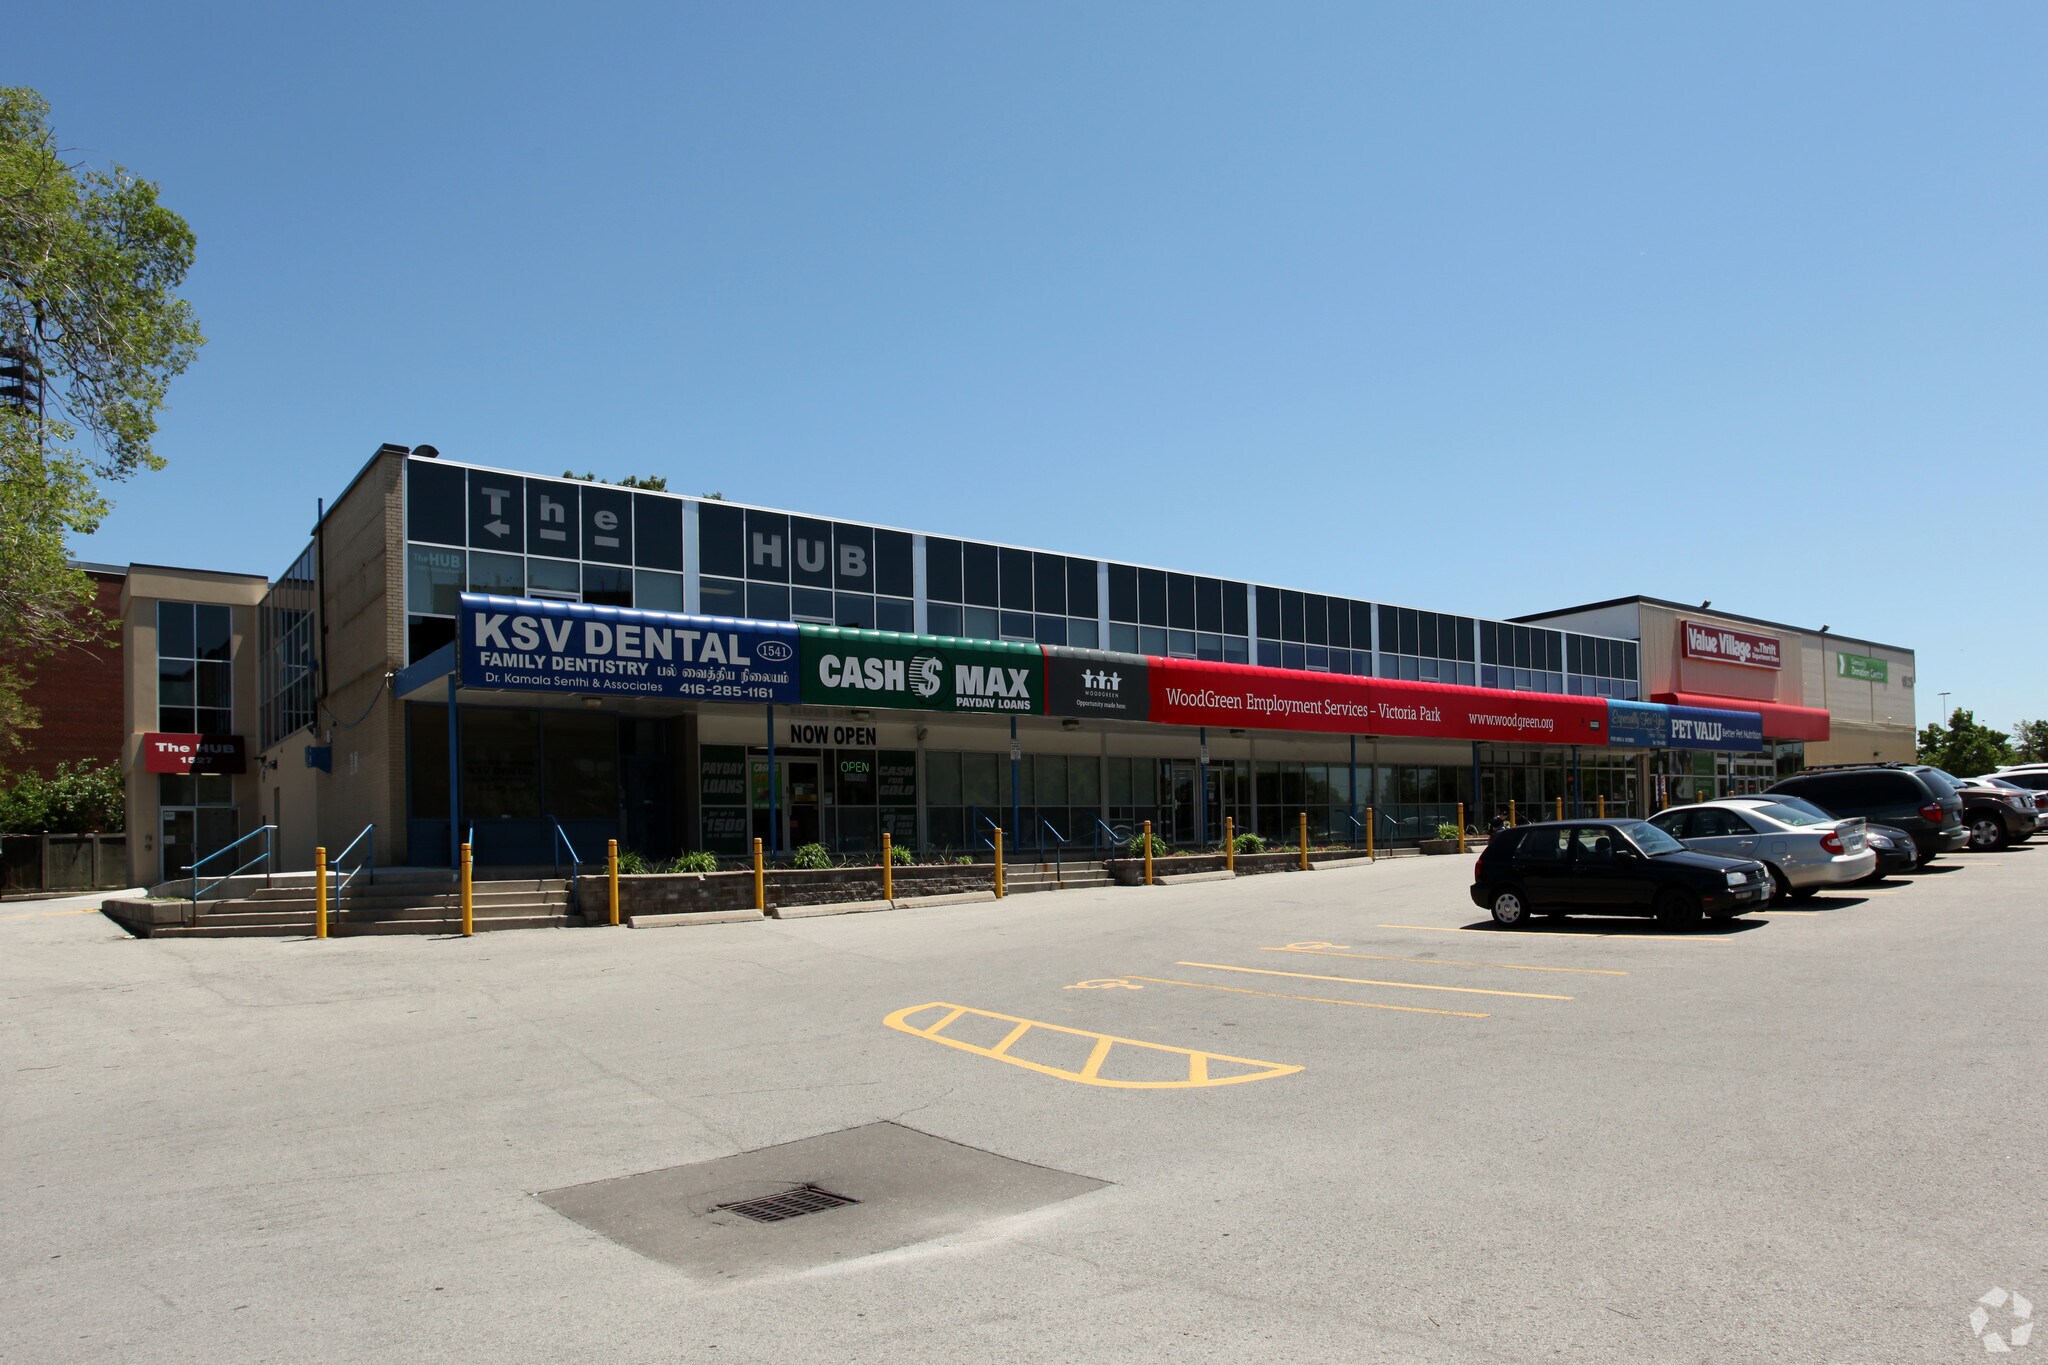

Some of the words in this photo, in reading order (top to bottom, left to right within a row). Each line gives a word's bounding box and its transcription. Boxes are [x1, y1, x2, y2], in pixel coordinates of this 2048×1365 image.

[482, 487, 618, 530] The
[429, 553, 461, 569] HUB
[752, 531, 867, 578] HUB
[475, 612, 574, 653] KSV
[584, 621, 751, 666] DENTAL
[1688, 627, 1718, 653] Value
[1718, 632, 1751, 662] Village
[762, 645, 786, 658] 1541
[1759, 642, 1777, 655] Thrift
[480, 651, 547, 669] FAMILY
[552, 656, 649, 676] DENTISTRY
[657, 663, 677, 677] பல்
[682, 667, 735, 682] வைத்திய
[740, 668, 790, 684] நிலையம்
[818, 654, 905, 691] CASH
[955, 664, 1030, 698] MAX
[485, 672, 501, 683] Dr.
[504, 673, 551, 685] Kamala
[554, 675, 589, 687] Senthi
[593, 678, 601, 688] &
[603, 679, 663, 692] Associates
[680, 683, 773, 698] 416-285-1161
[1084, 690, 1119, 698] WOODGREEN
[956, 697, 996, 708] PAYDAY
[998, 698, 1031, 710] LOANS
[1076, 699, 1104, 709] Opportunity
[1165, 687, 1242, 709] WoodGreen
[1246, 693, 1322, 717] Employment
[1324, 699, 1368, 717] Services
[1378, 703, 1417, 721] Victoria
[1419, 706, 1441, 722] Park
[1468, 712, 1554, 733] www.woodgreen.org
[1671, 719, 1693, 739] PET
[1693, 720, 1722, 741] VALU
[1722, 728, 1736, 738] Better
[1743, 730, 1762, 739] Nutrition
[790, 724, 828, 744] NOW
[834, 726, 877, 745] OPEN
[155, 742, 190, 753] The
[196, 743, 236, 754] HUB
[180, 756, 213, 764] 1527
[840, 761, 870, 773] OPEN
[701, 762, 744, 775] PAYDAY
[879, 765, 915, 776] CASH
[703, 779, 745, 794] LOANS
[879, 785, 915, 796] GOLD
[881, 815, 895, 834] 3
